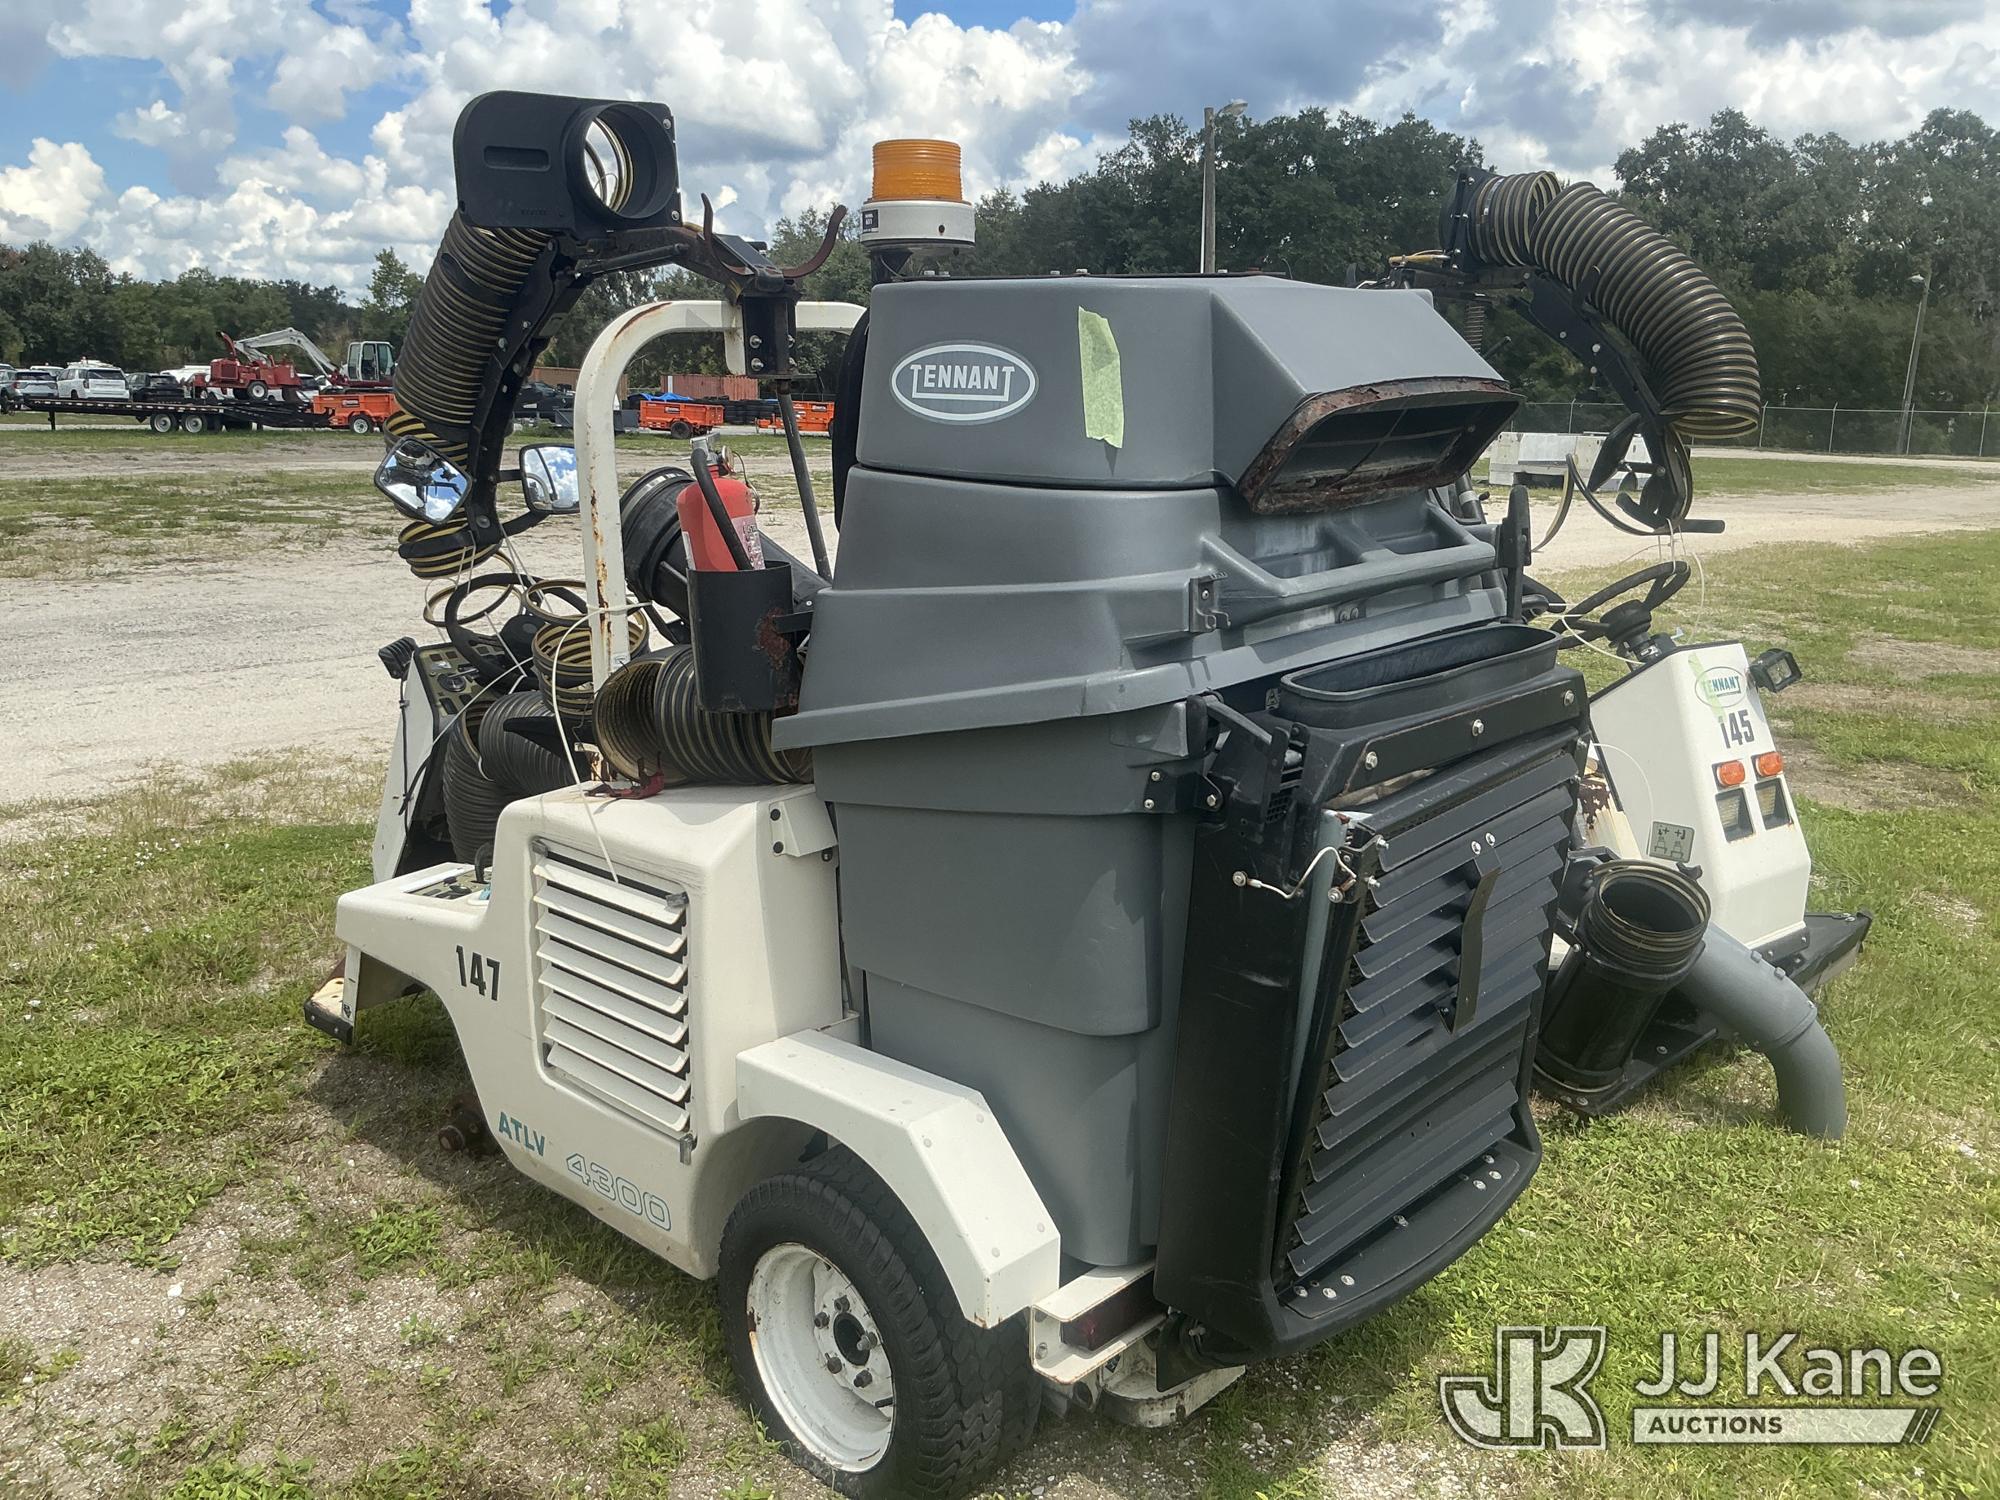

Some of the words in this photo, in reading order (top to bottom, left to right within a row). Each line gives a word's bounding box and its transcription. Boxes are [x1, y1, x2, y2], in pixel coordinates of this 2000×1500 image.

[910, 365, 1015, 401] TENNANT
[1718, 709, 1755, 749] 145
[455, 944, 501, 1001] 147
[499, 1111, 546, 1157] ATLV
[566, 1153, 672, 1231] 4300
